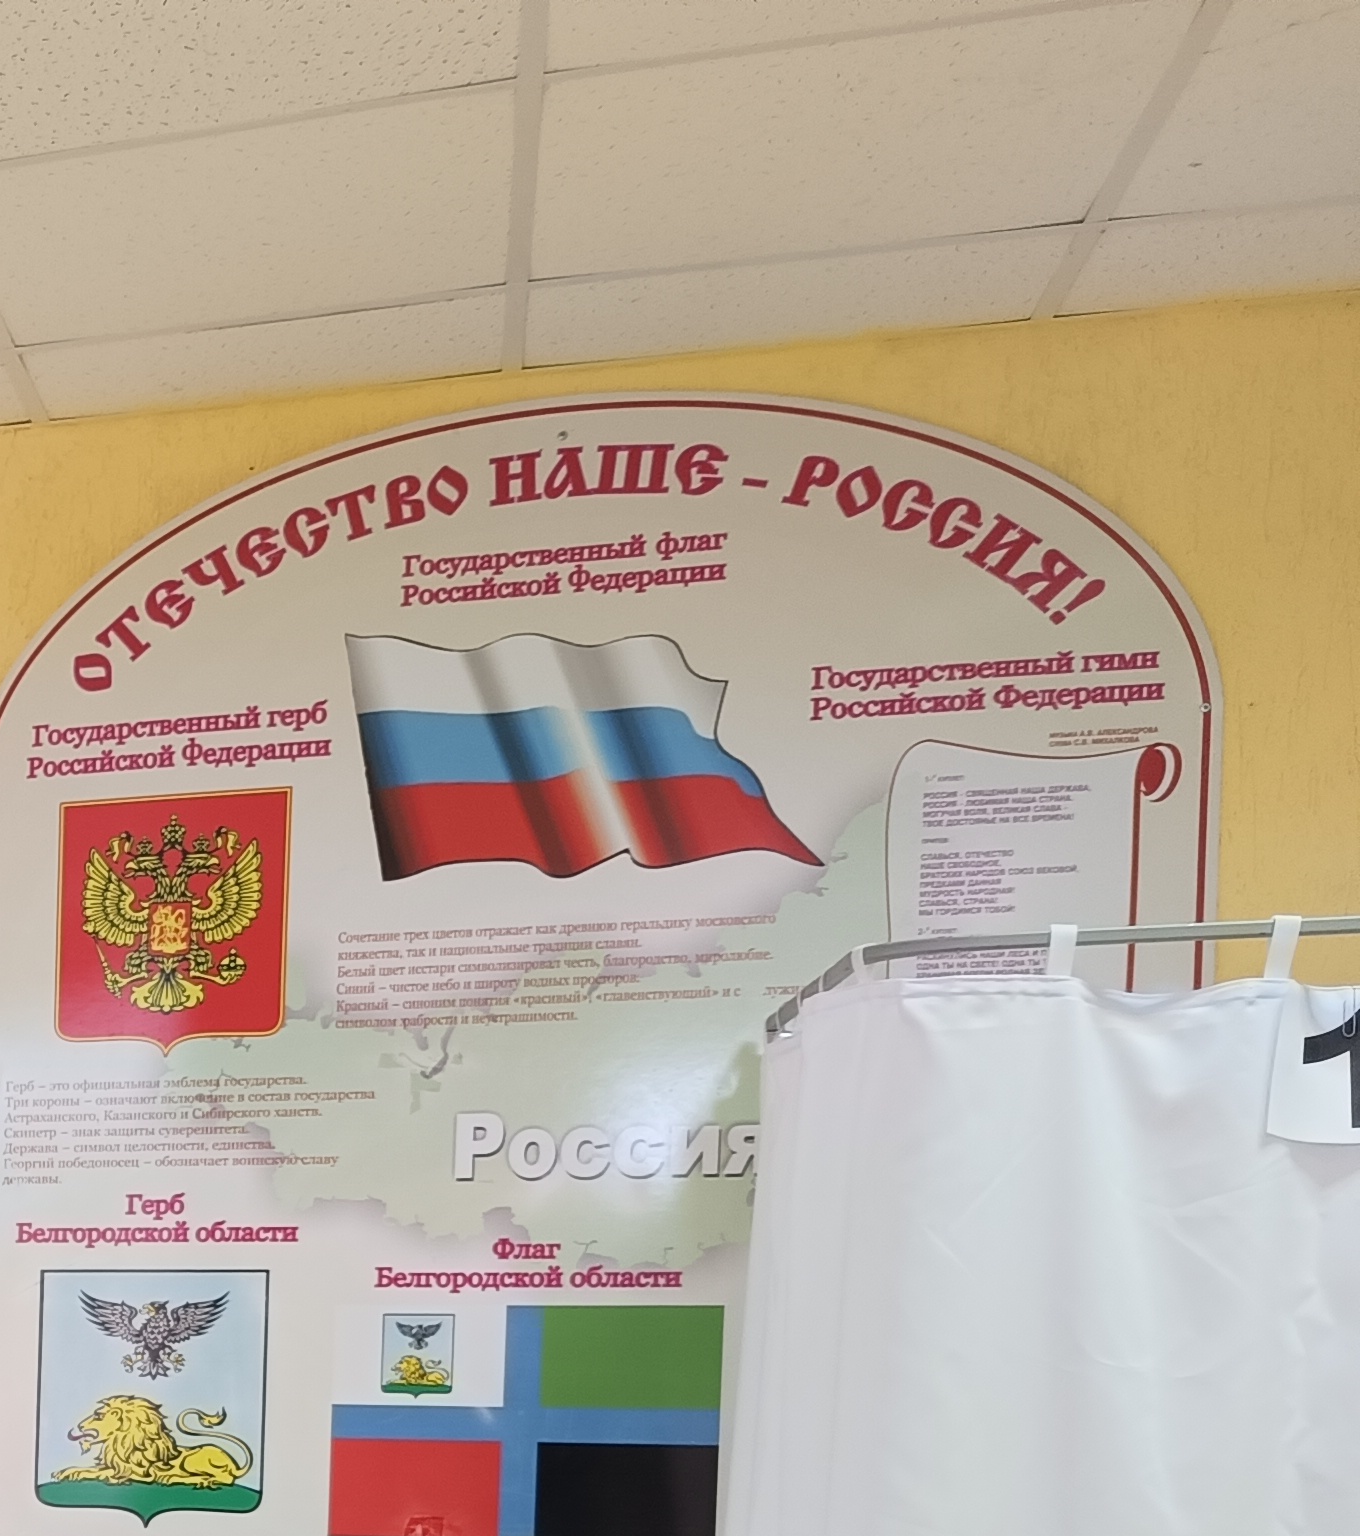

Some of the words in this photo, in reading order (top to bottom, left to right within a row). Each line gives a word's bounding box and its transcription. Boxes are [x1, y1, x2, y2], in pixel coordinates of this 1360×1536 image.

[73, 465, 468, 692] ОТЕЧЕСТВО
[490, 443, 729, 506] НАШЕ
[782, 455, 1106, 625] РОССИЯ!
[402, 534, 647, 579] Государственный
[655, 531, 728, 560] флаг
[400, 572, 561, 607] Российской
[568, 564, 726, 594] Федерации
[811, 651, 1074, 691] Государственный
[1081, 651, 1160, 673] гимн
[810, 688, 986, 721] Российской
[993, 684, 1165, 710] Федерации
[32, 706, 261, 748] Государственный
[266, 700, 329, 731] герб
[27, 745, 176, 779] Российской
[181, 738, 332, 767] Федерации
[125, 1193, 186, 1221] Герб
[15, 1221, 189, 1248] Белгородской
[196, 1220, 299, 1243] области
[492, 1237, 561, 1262] Флаг
[374, 1266, 563, 1293] Белгородской
[570, 1265, 683, 1289] области
